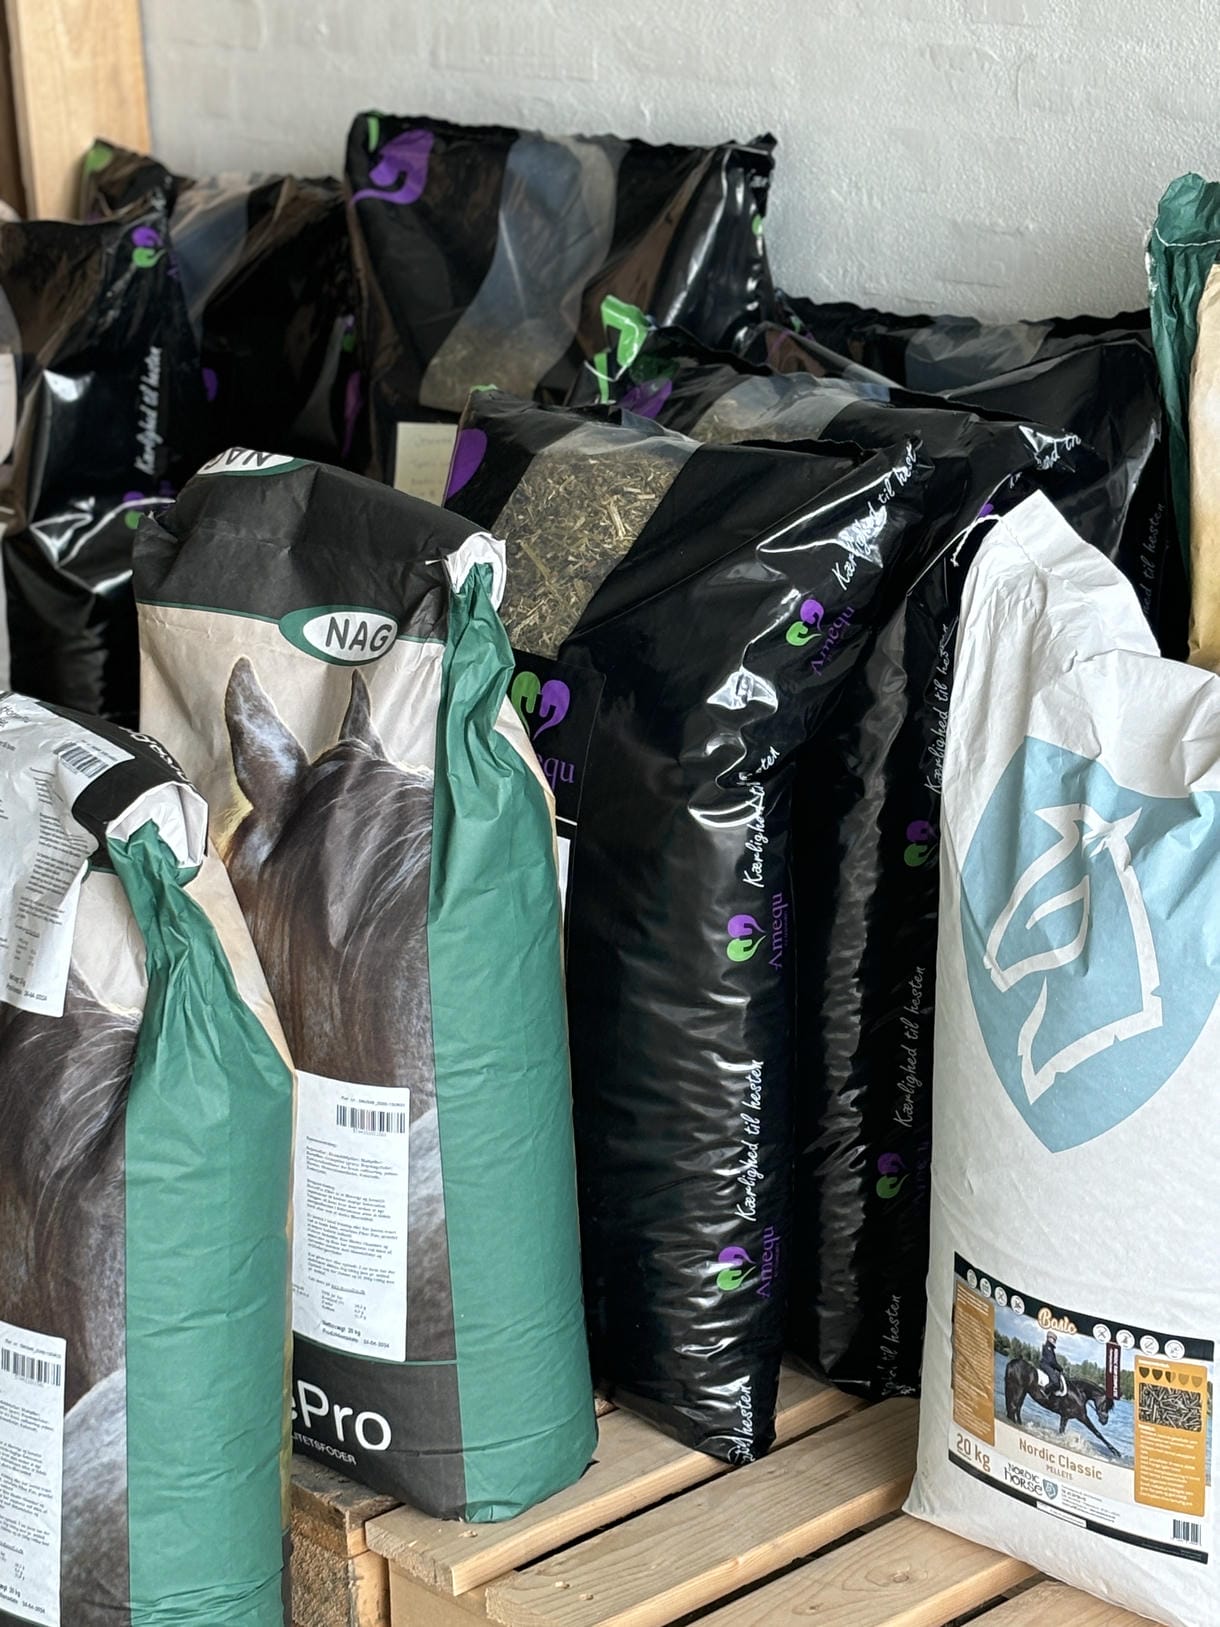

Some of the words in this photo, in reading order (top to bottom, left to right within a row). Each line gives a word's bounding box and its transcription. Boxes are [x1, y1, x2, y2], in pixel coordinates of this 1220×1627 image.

[878, 478, 898, 505] til
[325, 616, 393, 652] NAG
[809, 604, 856, 677] Amequ
[769, 892, 786, 971] Amequ
[903, 964, 926, 1015] hesten
[898, 1016, 920, 1041] til
[741, 1059, 764, 1111] hesten
[892, 1043, 923, 1128] Kærlighed
[740, 1112, 761, 1136] til
[734, 1139, 765, 1222] Kærlighed
[757, 1225, 775, 1299] Amequ
[882, 1292, 902, 1345] hesten
[1037, 1306, 1078, 1336] Basic
[733, 1382, 754, 1437] hesten
[956, 1433, 972, 1457] 20
[974, 1444, 991, 1474] kg
[1008, 1462, 1040, 1484] NORDIC
[1019, 1438, 1055, 1466] Nordic
[1058, 1454, 1103, 1481] Classic
[1046, 1464, 1074, 1481] PELLETS
